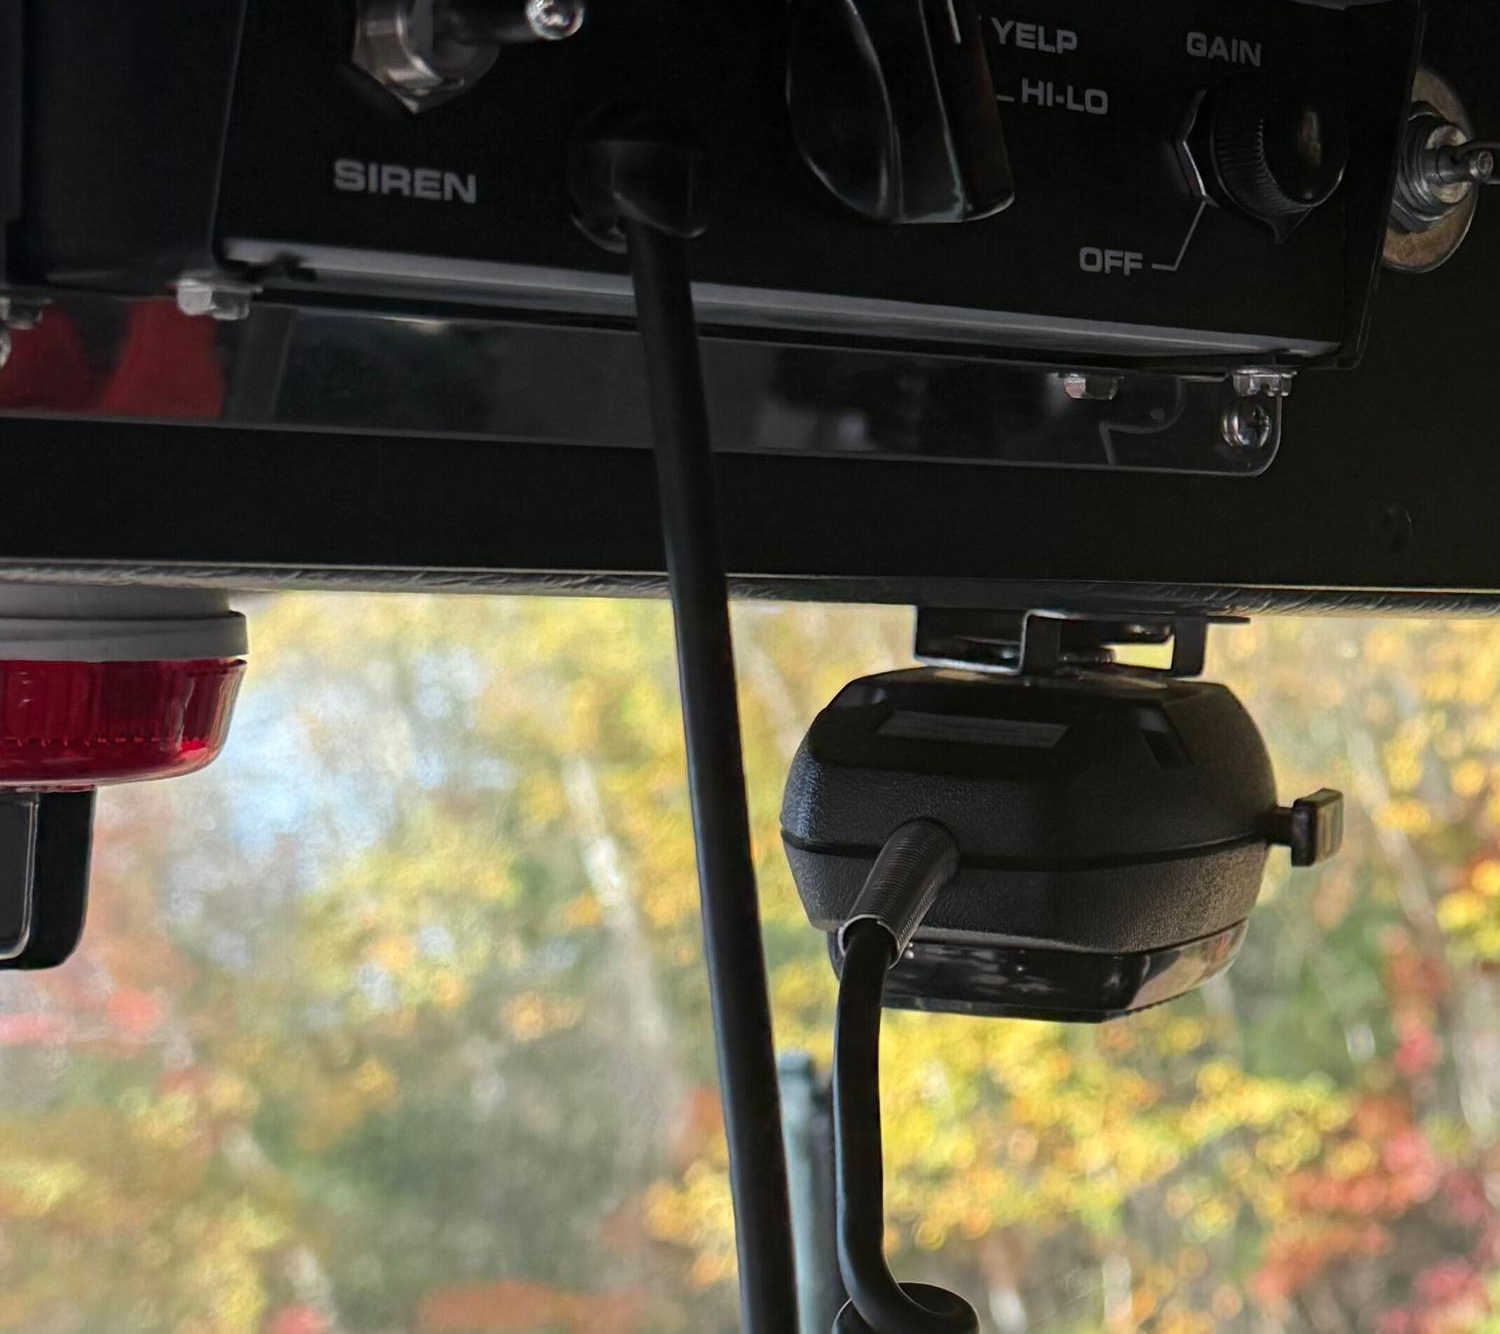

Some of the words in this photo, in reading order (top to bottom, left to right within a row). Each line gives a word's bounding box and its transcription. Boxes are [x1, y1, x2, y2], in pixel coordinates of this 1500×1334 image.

[990, 16, 1079, 55] YELP
[1186, 30, 1262, 67] GAIN
[1021, 77, 1109, 115] HI-LO
[333, 159, 477, 205] SIREN
[1079, 245, 1144, 276] OFF
